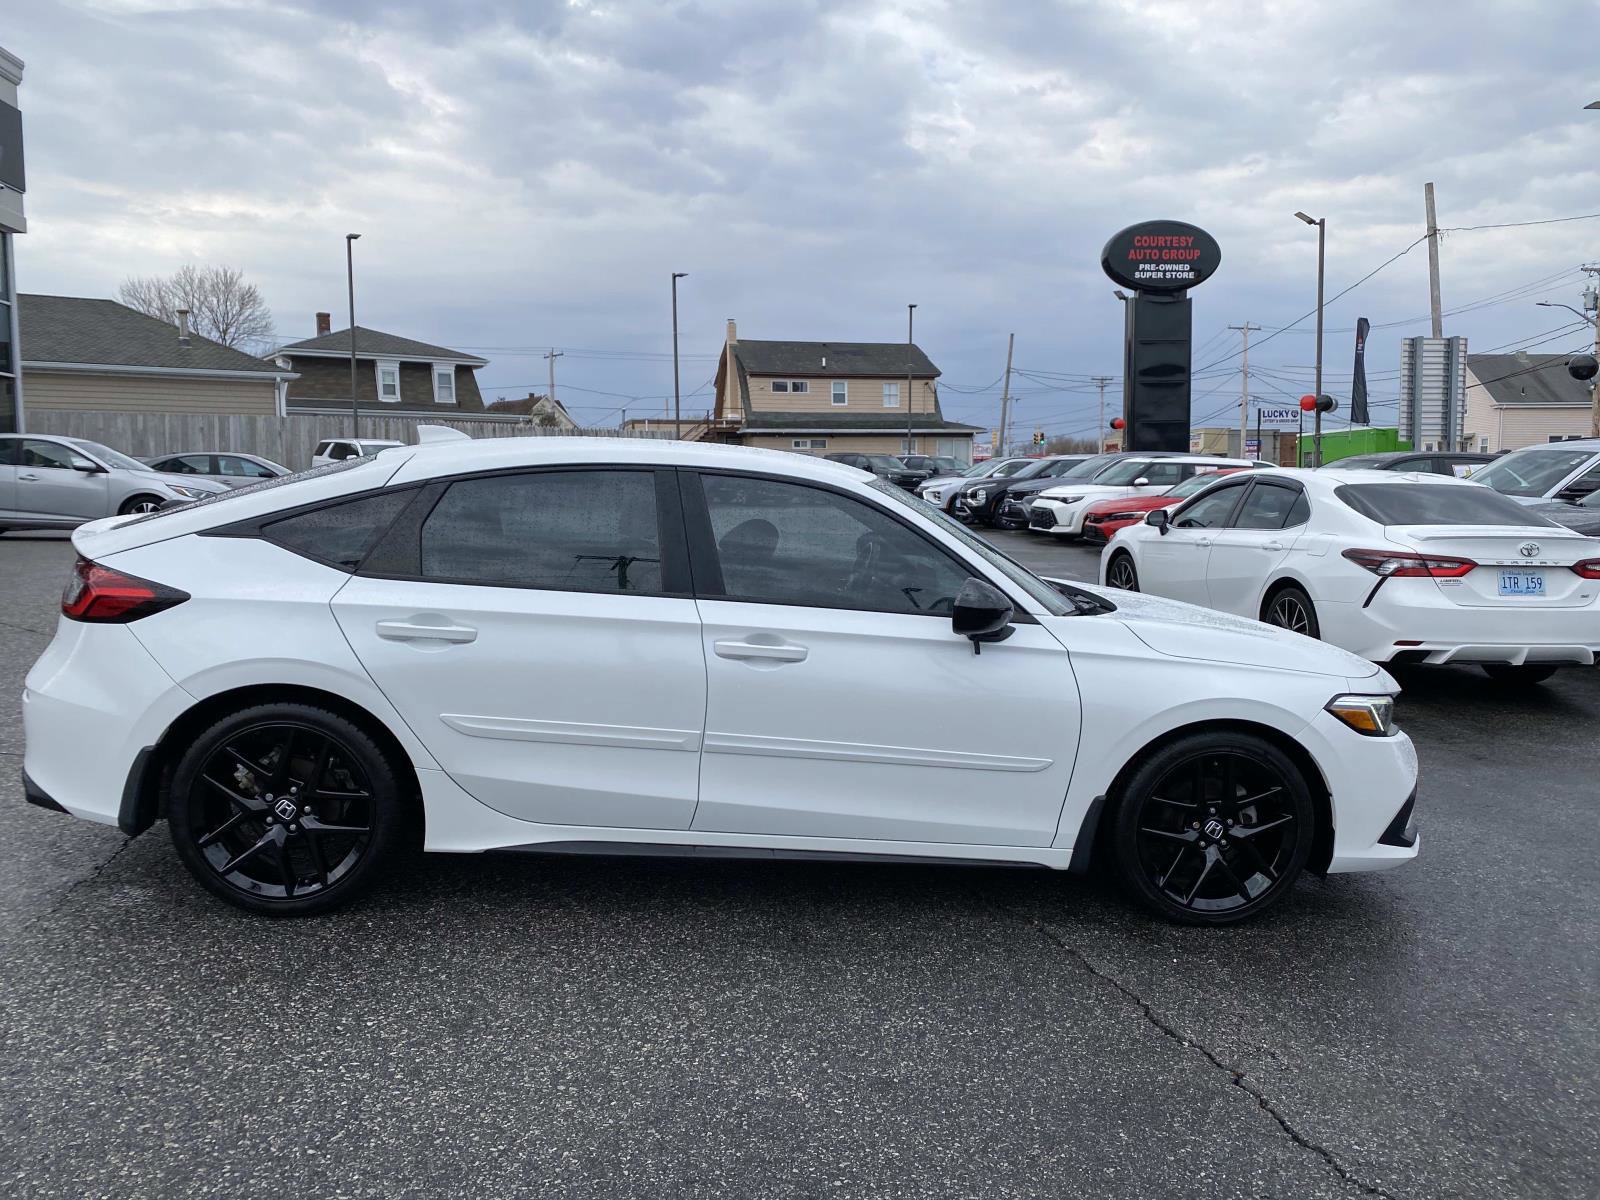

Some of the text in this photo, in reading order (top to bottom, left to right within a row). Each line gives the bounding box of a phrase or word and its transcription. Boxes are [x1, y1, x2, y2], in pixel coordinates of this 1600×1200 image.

[1134, 236, 1194, 247] COURTESY
[1128, 250, 1200, 260] AUTO GROUP
[1134, 271, 1195, 279] SUPER STORE
[1262, 410, 1290, 418] LUCKY
[1502, 576, 1543, 590] 1TR 159
